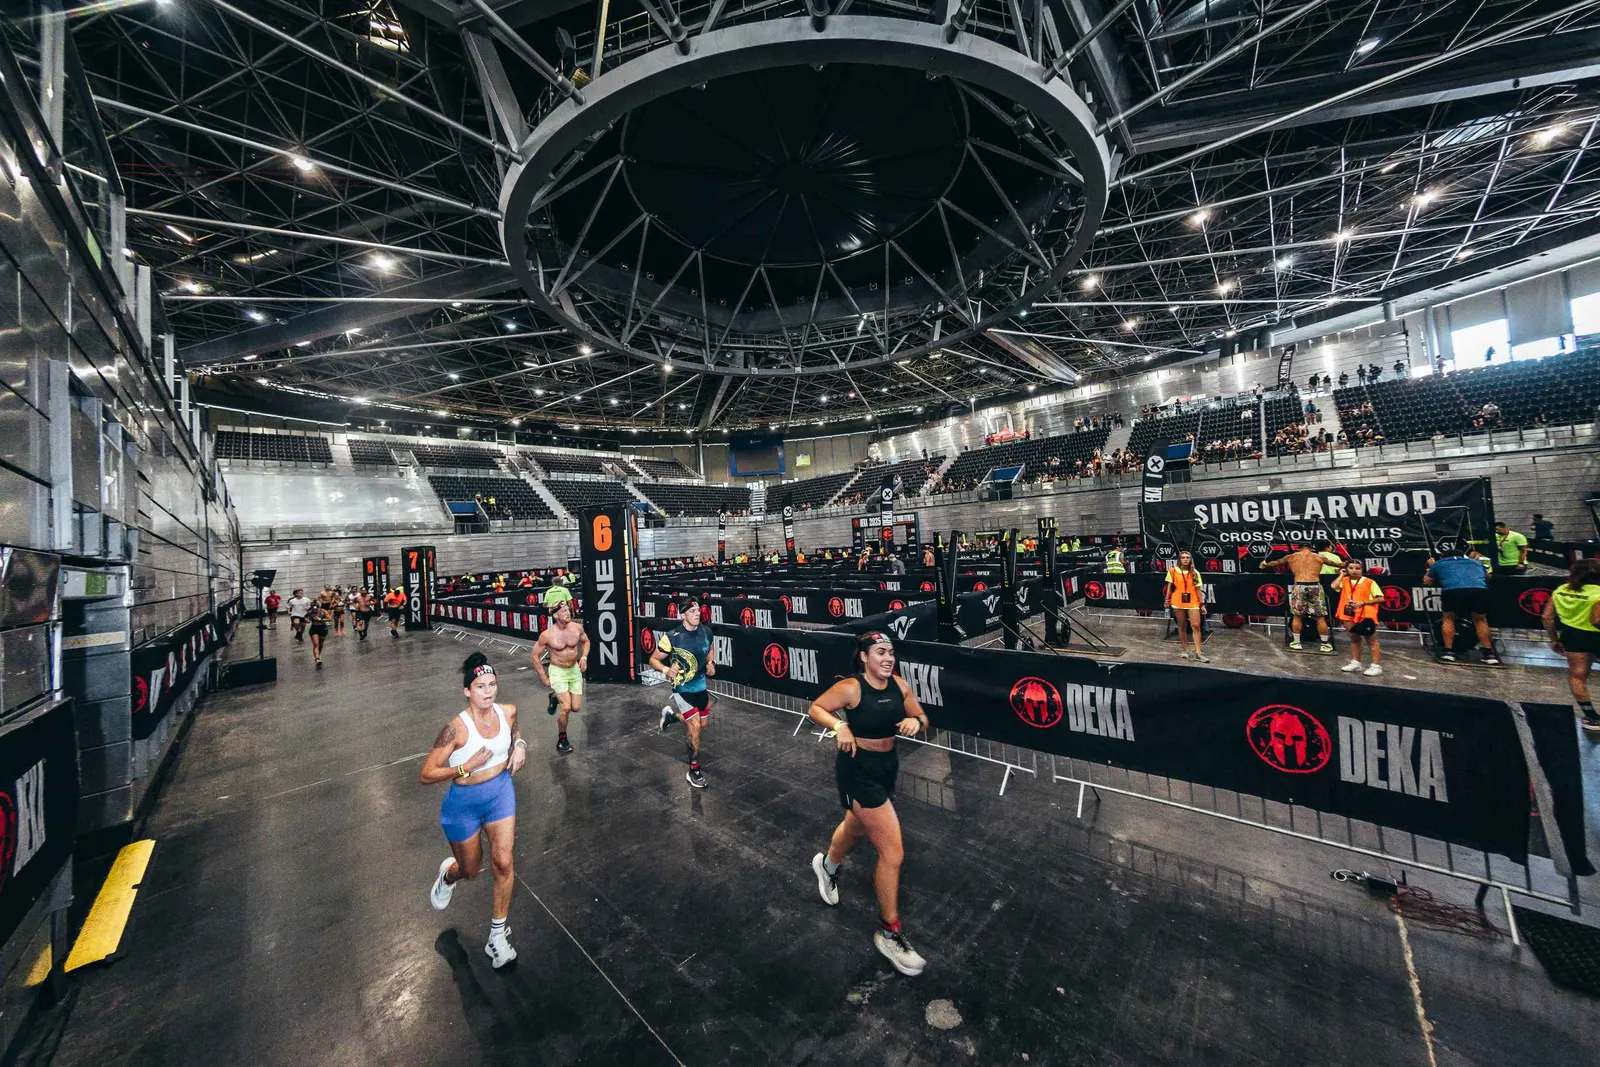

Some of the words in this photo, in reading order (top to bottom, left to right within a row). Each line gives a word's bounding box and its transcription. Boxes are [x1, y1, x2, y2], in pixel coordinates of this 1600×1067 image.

[1194, 490, 1436, 524] SINGULARWOD
[593, 514, 613, 551] 6
[1220, 531, 1273, 542] CROSS
[1334, 527, 1402, 540] LIMITS
[1159, 546, 1172, 555] SW
[1202, 546, 1217, 555] SW
[1251, 545, 1267, 555] SW
[1374, 543, 1393, 552] SW
[408, 551, 418, 570] 7
[409, 572, 421, 623] ZONE
[1105, 582, 1129, 600] DEKA
[595, 558, 619, 666] ZONE
[792, 597, 807, 614] DEKA
[845, 599, 863, 618] DEKA
[755, 609, 772, 628] DEKA
[788, 646, 819, 685] DEKA
